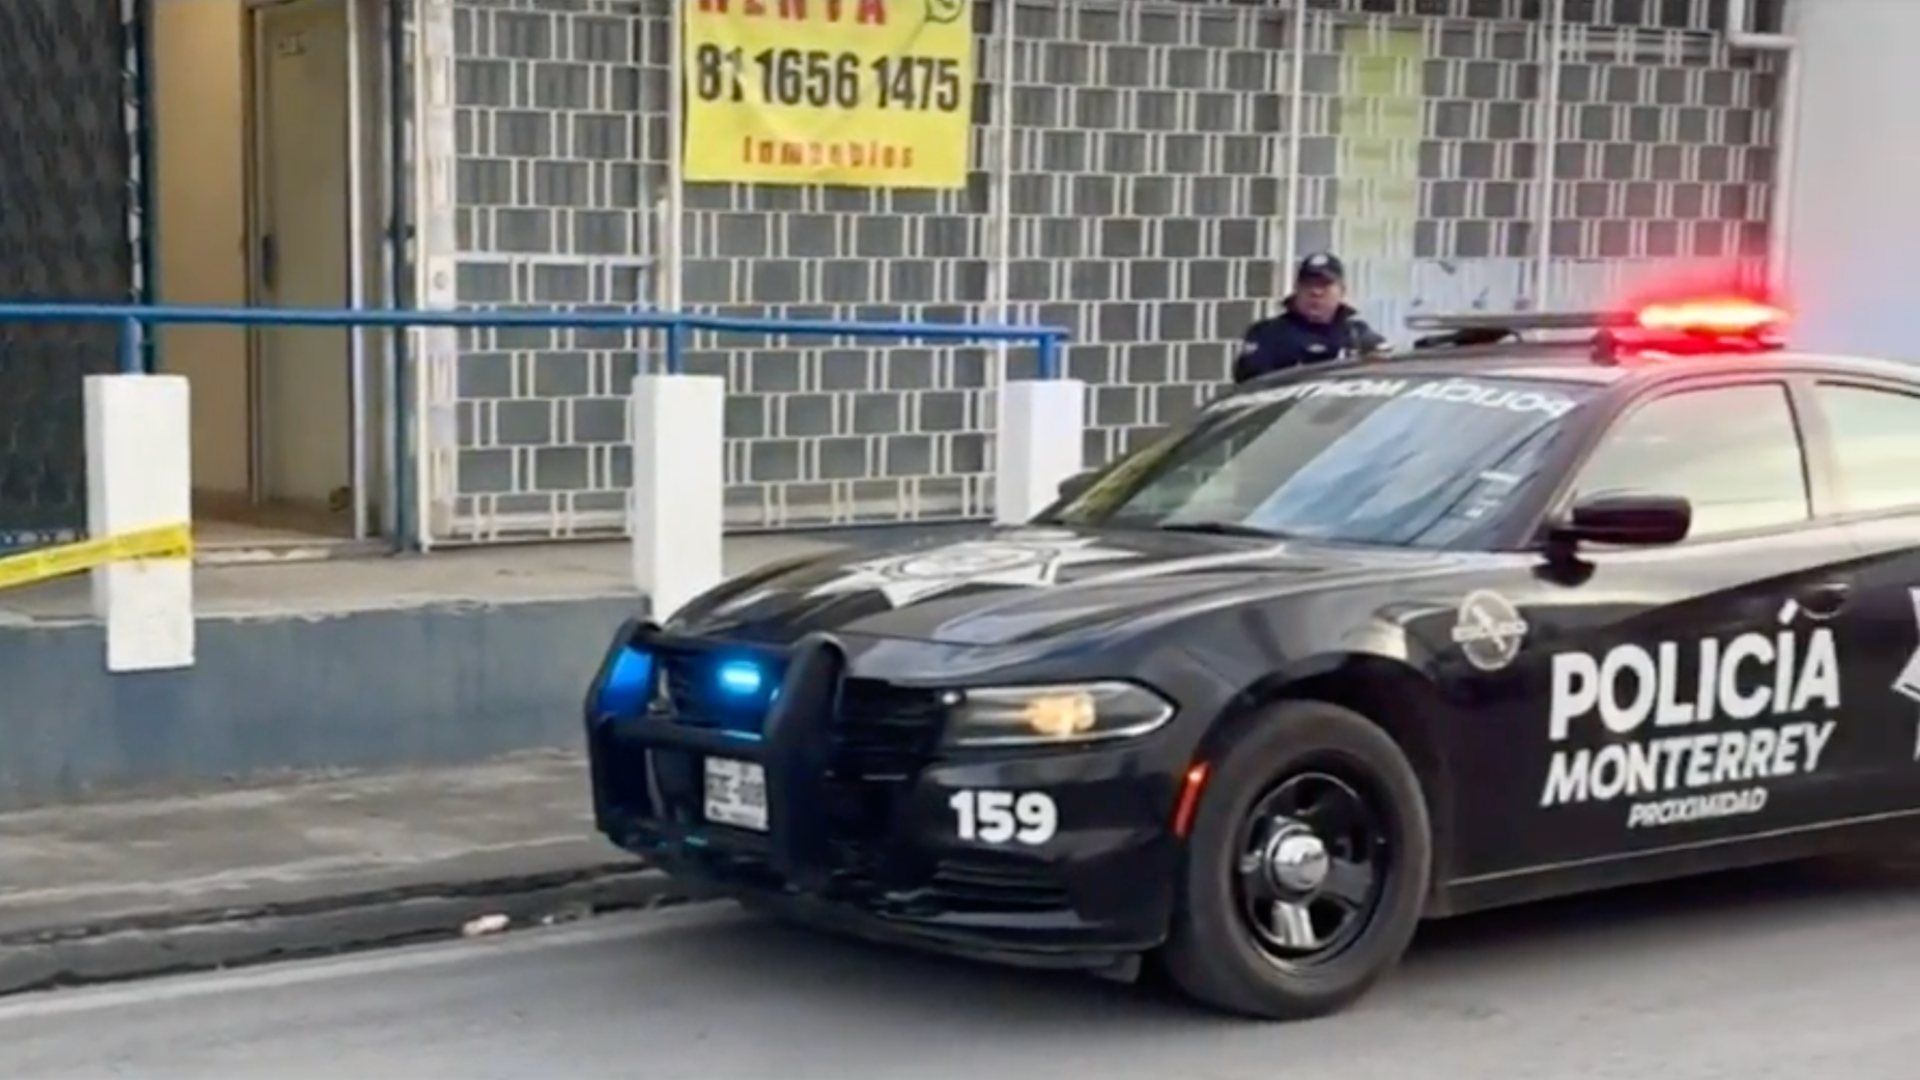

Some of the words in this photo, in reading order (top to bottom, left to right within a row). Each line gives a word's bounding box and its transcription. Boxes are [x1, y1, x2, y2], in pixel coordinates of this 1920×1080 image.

[698, 43, 743, 102] 81
[755, 48, 859, 108] 1656
[871, 56, 960, 111] 1475
[1549, 599, 1840, 740] POLICÍA
[1540, 721, 1837, 807] MONTERREY
[949, 789, 1057, 845] 159
[1627, 786, 1768, 828] PROXIMIDAD
